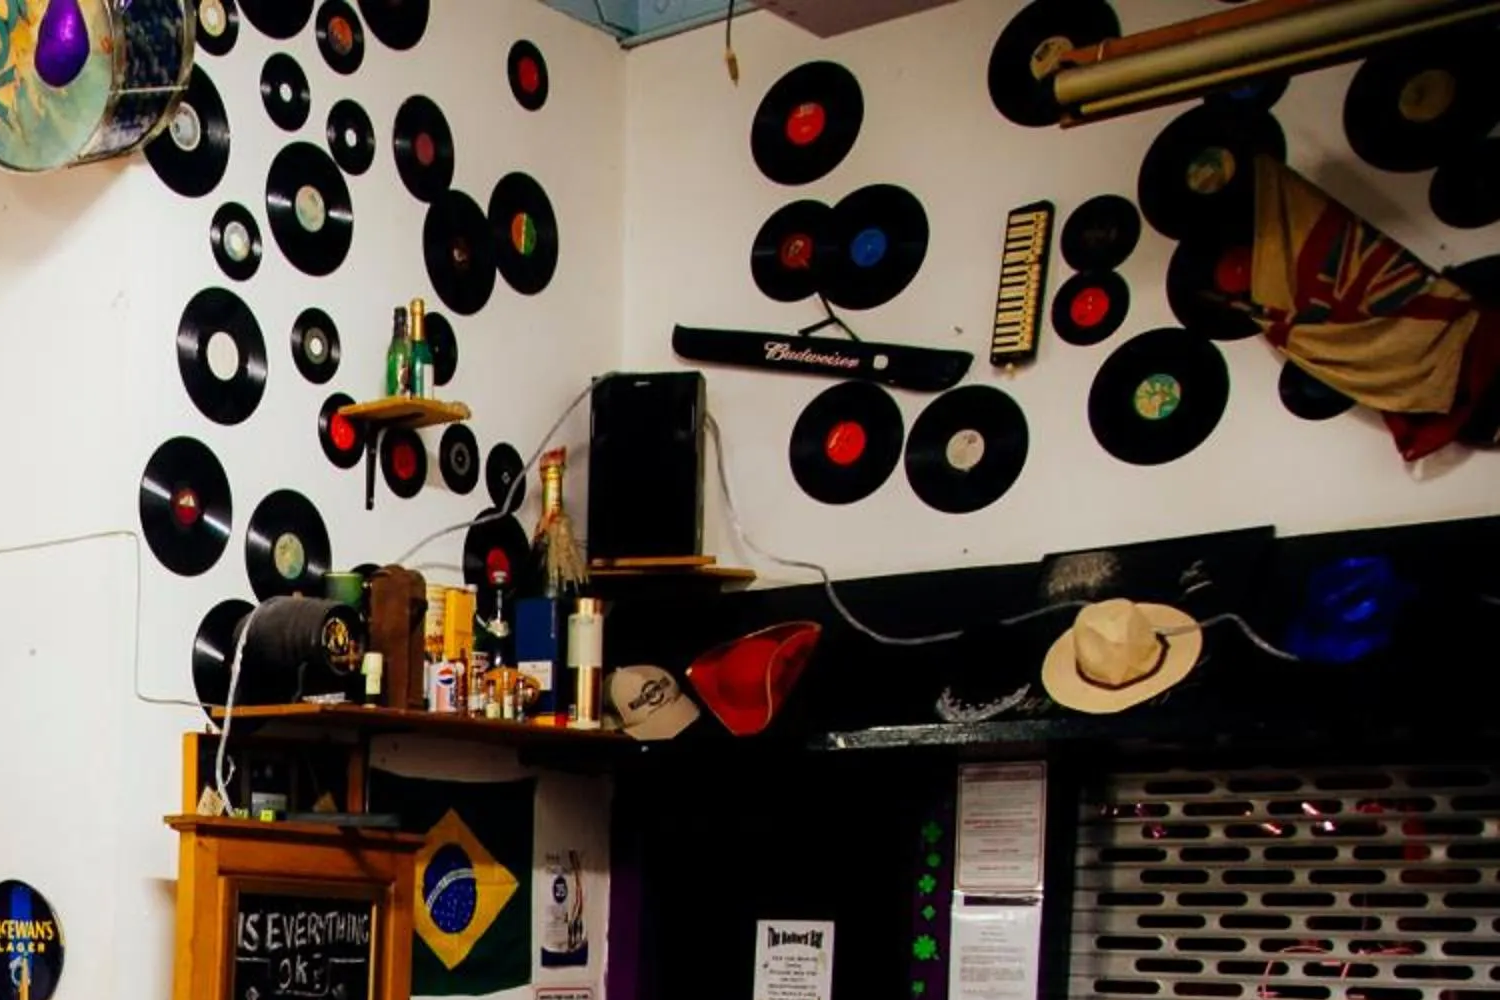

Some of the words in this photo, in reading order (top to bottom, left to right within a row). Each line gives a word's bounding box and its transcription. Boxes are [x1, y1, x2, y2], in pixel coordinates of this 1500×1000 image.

[762, 340, 860, 369] Budweiser
[237, 911, 260, 951] IS
[265, 911, 369, 950] EVERYTHING
